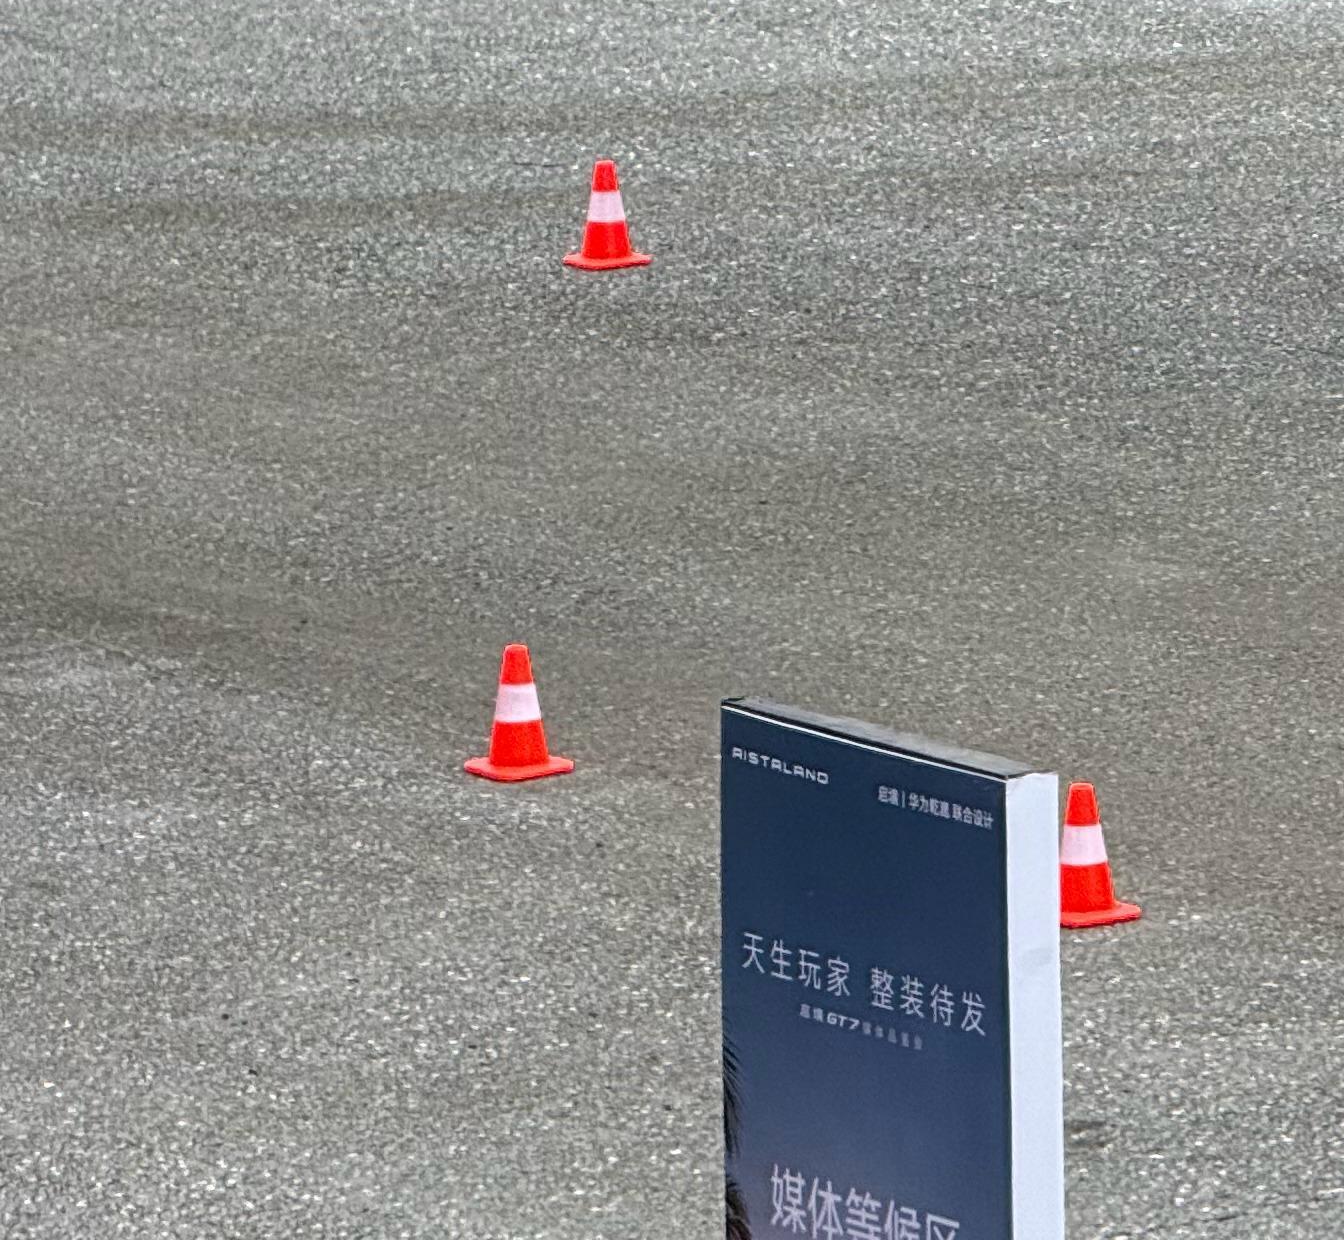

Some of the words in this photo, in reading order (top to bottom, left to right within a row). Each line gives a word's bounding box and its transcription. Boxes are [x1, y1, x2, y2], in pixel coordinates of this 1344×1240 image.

[742, 932, 851, 997] 天生玩家
[869, 967, 986, 1037] 整装待发
